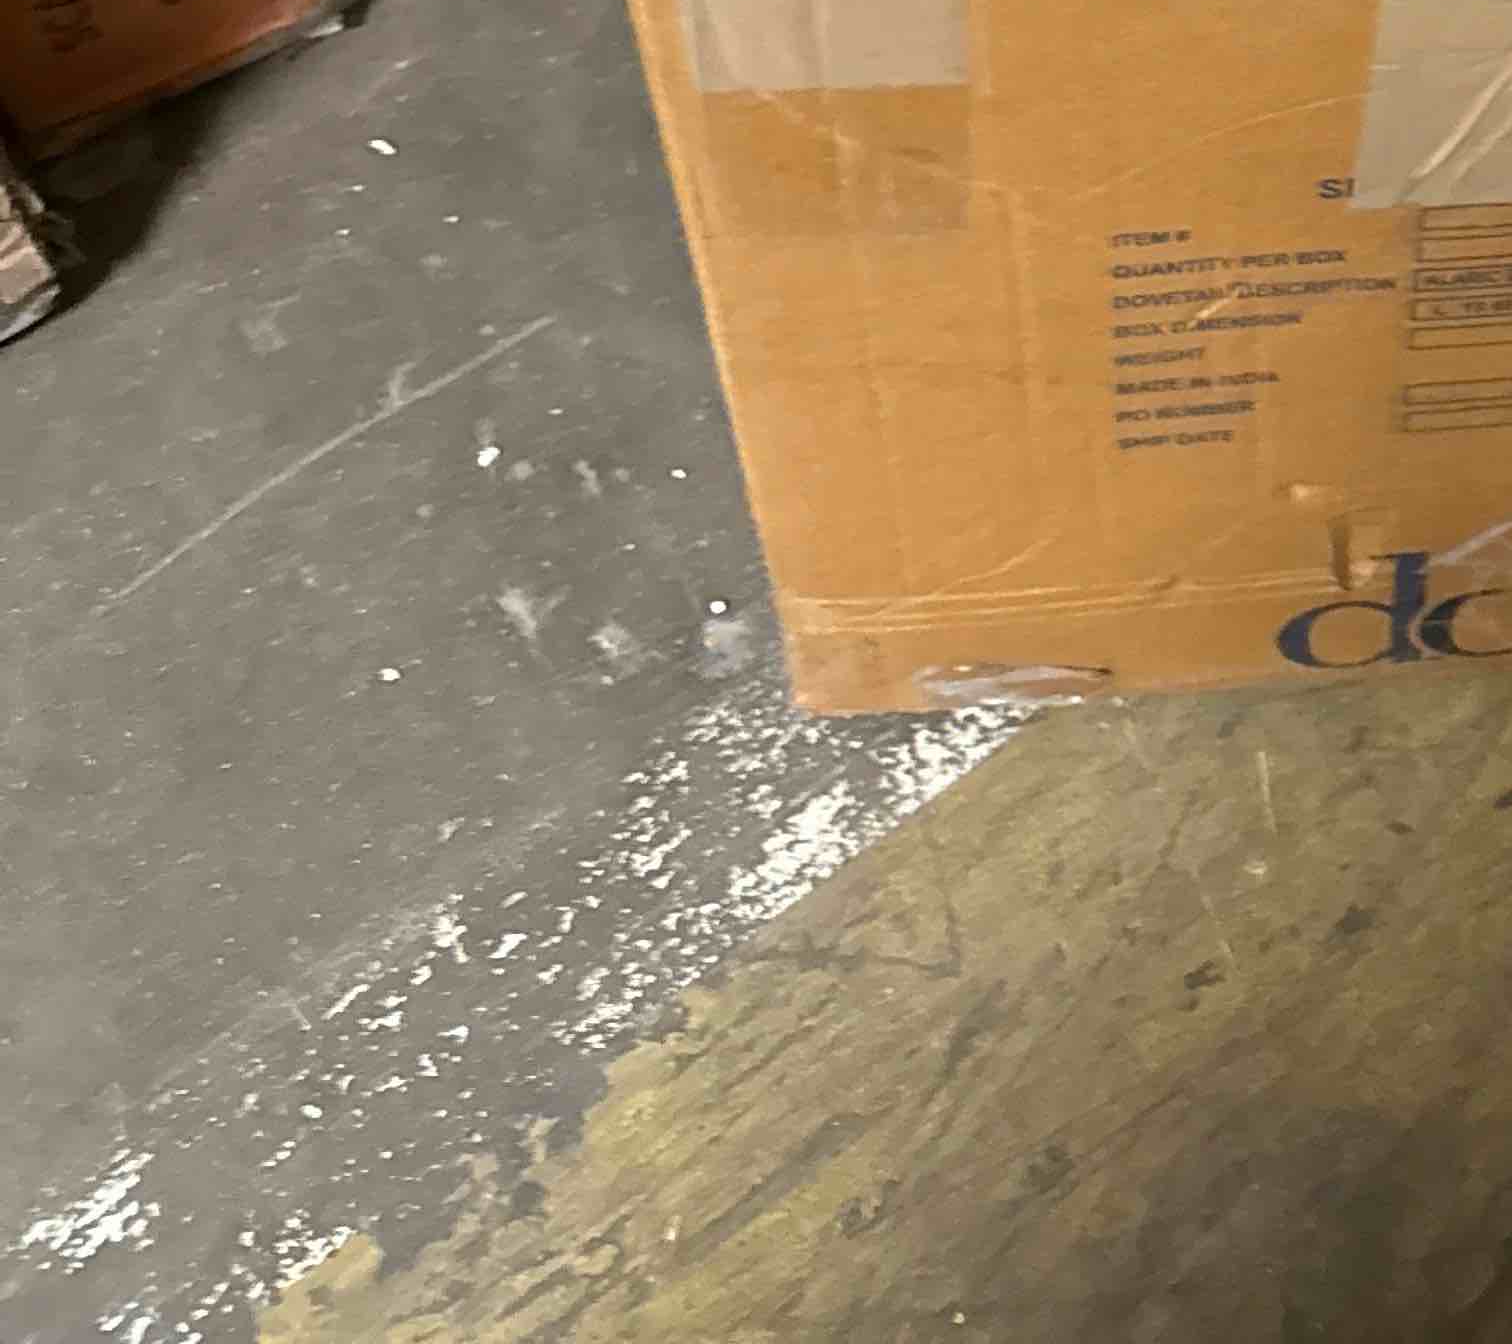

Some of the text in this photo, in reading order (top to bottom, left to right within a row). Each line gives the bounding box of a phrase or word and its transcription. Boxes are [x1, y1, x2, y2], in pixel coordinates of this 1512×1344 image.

[1112, 231, 1170, 247] ITEM
[1112, 250, 1346, 278] QUANTITY PER BOX
[1230, 278, 1396, 299] DESCRIPTION
[1114, 322, 1164, 338] BOX
[1116, 378, 1185, 395] MADE
